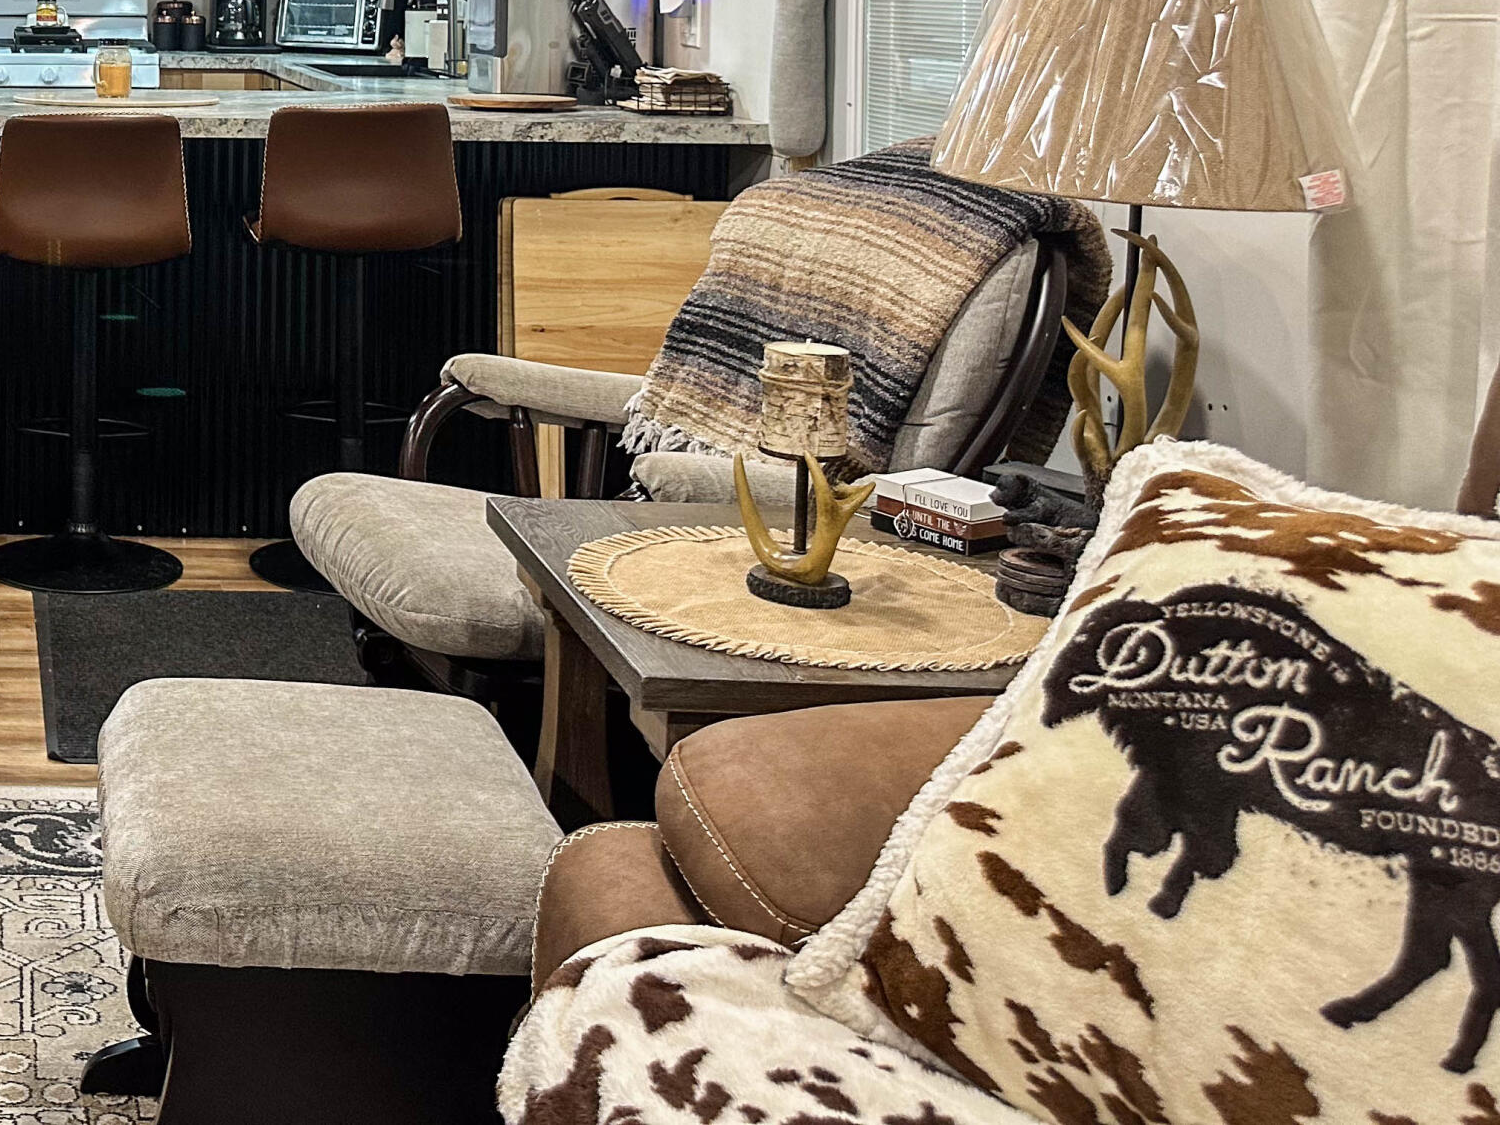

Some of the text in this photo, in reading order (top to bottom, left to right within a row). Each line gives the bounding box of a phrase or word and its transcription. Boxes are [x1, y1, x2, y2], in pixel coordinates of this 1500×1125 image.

[930, 498, 949, 513] LOVE
[953, 504, 968, 518] YOU
[912, 510, 951, 531] UNTIL THE
[920, 528, 940, 544] COME
[943, 535, 964, 552] HOME
[1068, 620, 1309, 694] Dutton
[1107, 691, 1230, 710] MONTANA
[1180, 713, 1227, 730] USA
[1216, 701, 1460, 813] Ranch
[1359, 808, 1500, 847] FOUNDED
